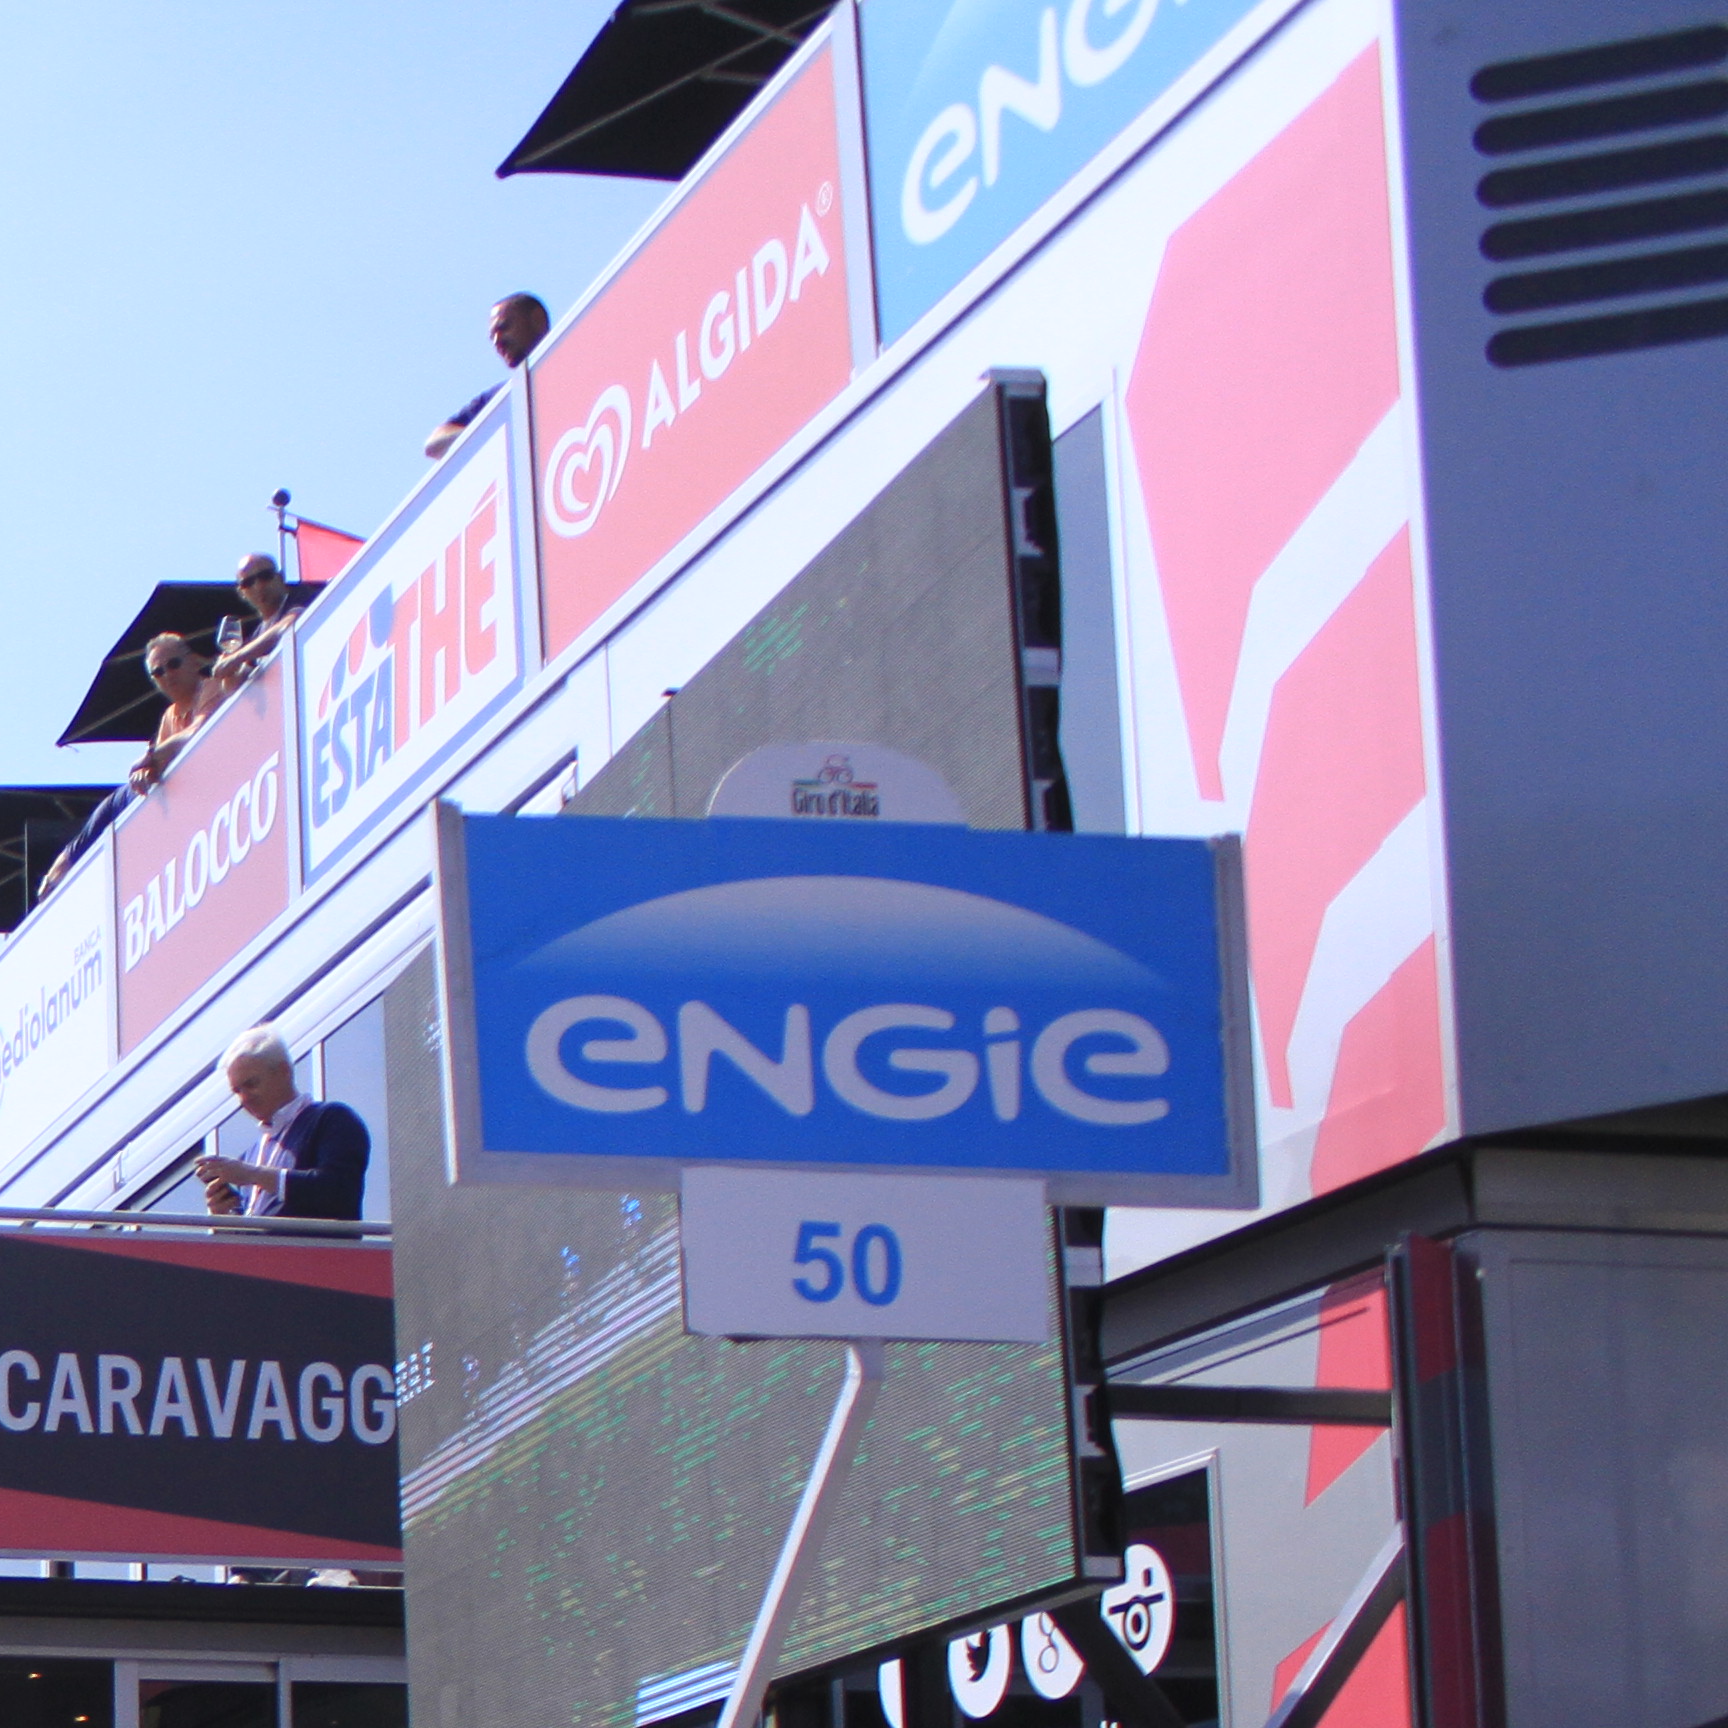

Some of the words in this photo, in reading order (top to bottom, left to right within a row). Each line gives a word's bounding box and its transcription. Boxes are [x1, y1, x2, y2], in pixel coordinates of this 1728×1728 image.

[641, 203, 832, 450] ALGIDA
[123, 751, 281, 975] BALOCCO
[791, 1220, 904, 1307] 50
